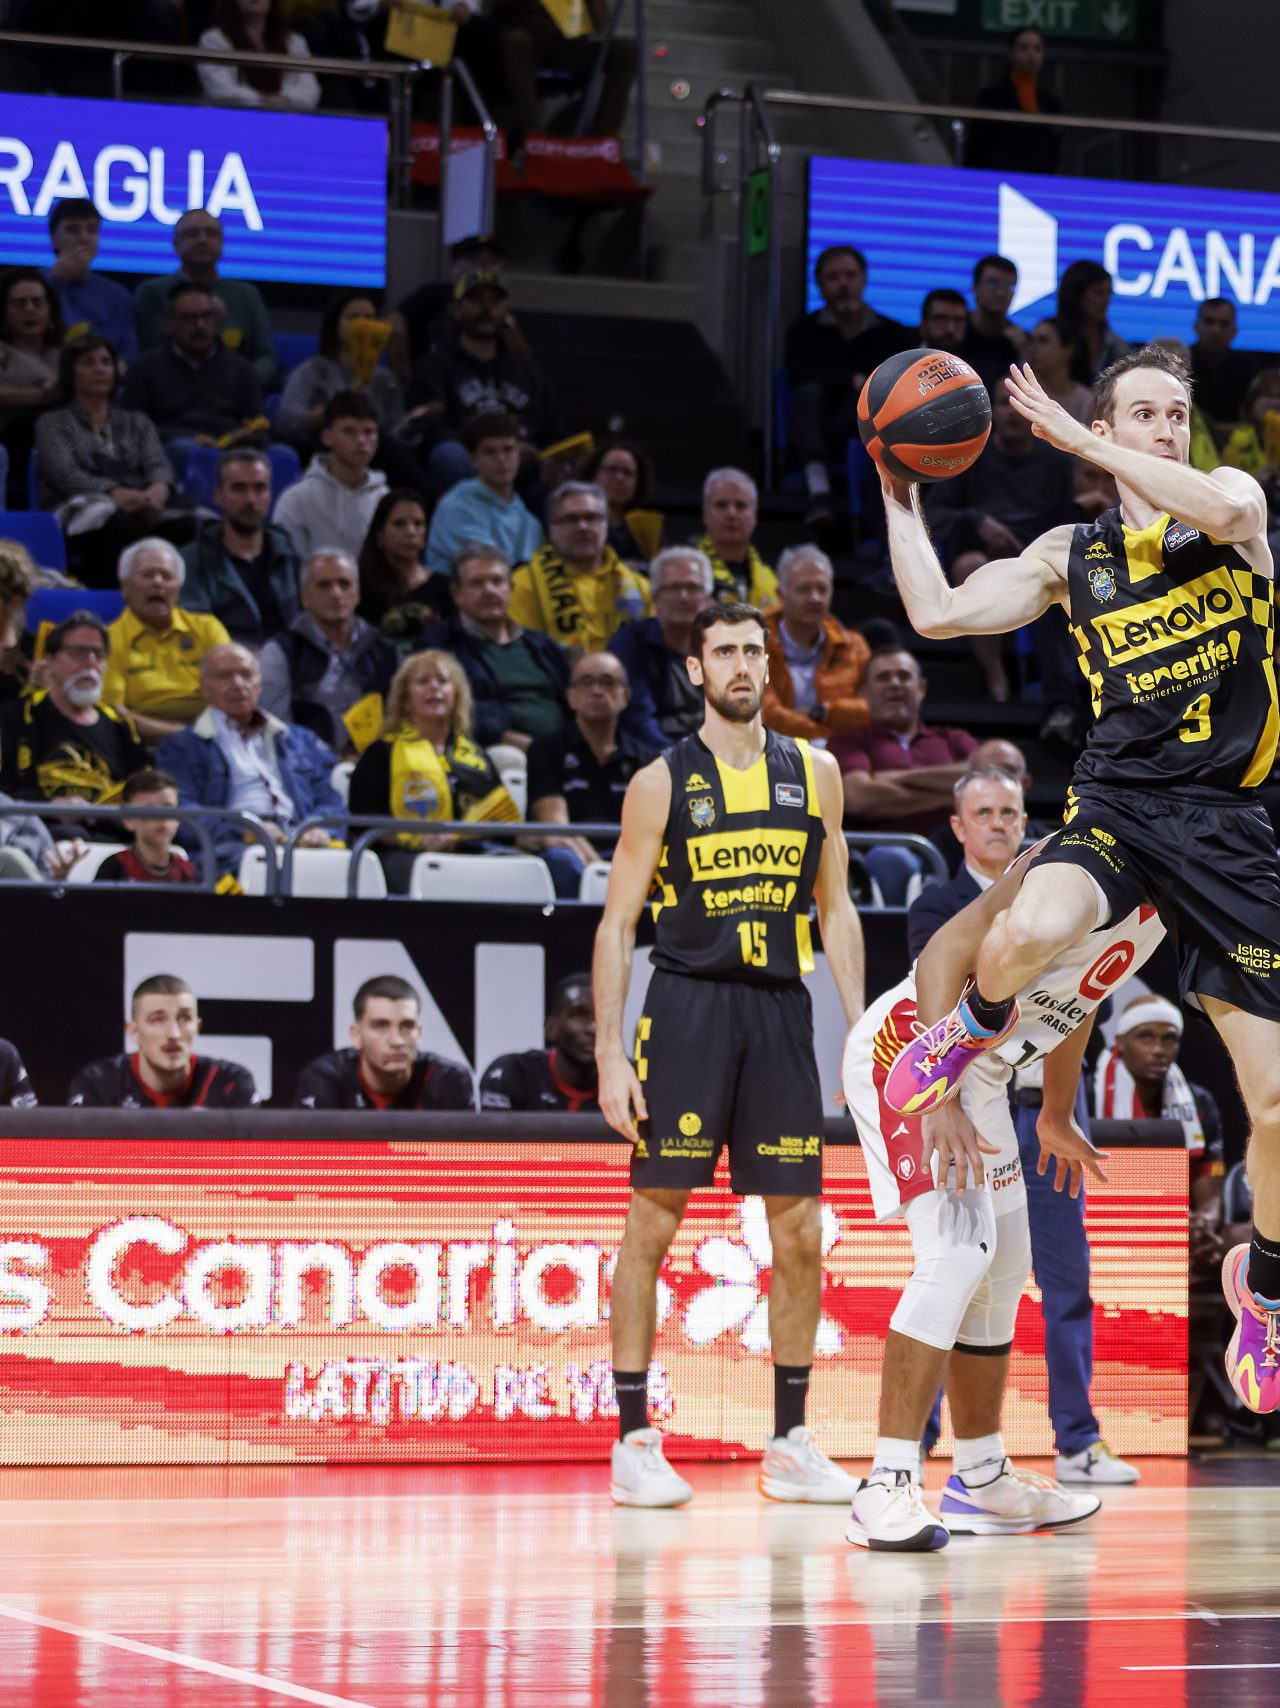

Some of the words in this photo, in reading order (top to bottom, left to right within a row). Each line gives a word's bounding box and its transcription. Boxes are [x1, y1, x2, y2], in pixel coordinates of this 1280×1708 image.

[1002, 0, 1079, 28] EXIT
[1101, 588, 1232, 656] Lenovo
[1132, 683, 1182, 704] despierta
[694, 844, 800, 872] Lenovo
[737, 921, 768, 967] 15
[1238, 943, 1271, 959] Islas
